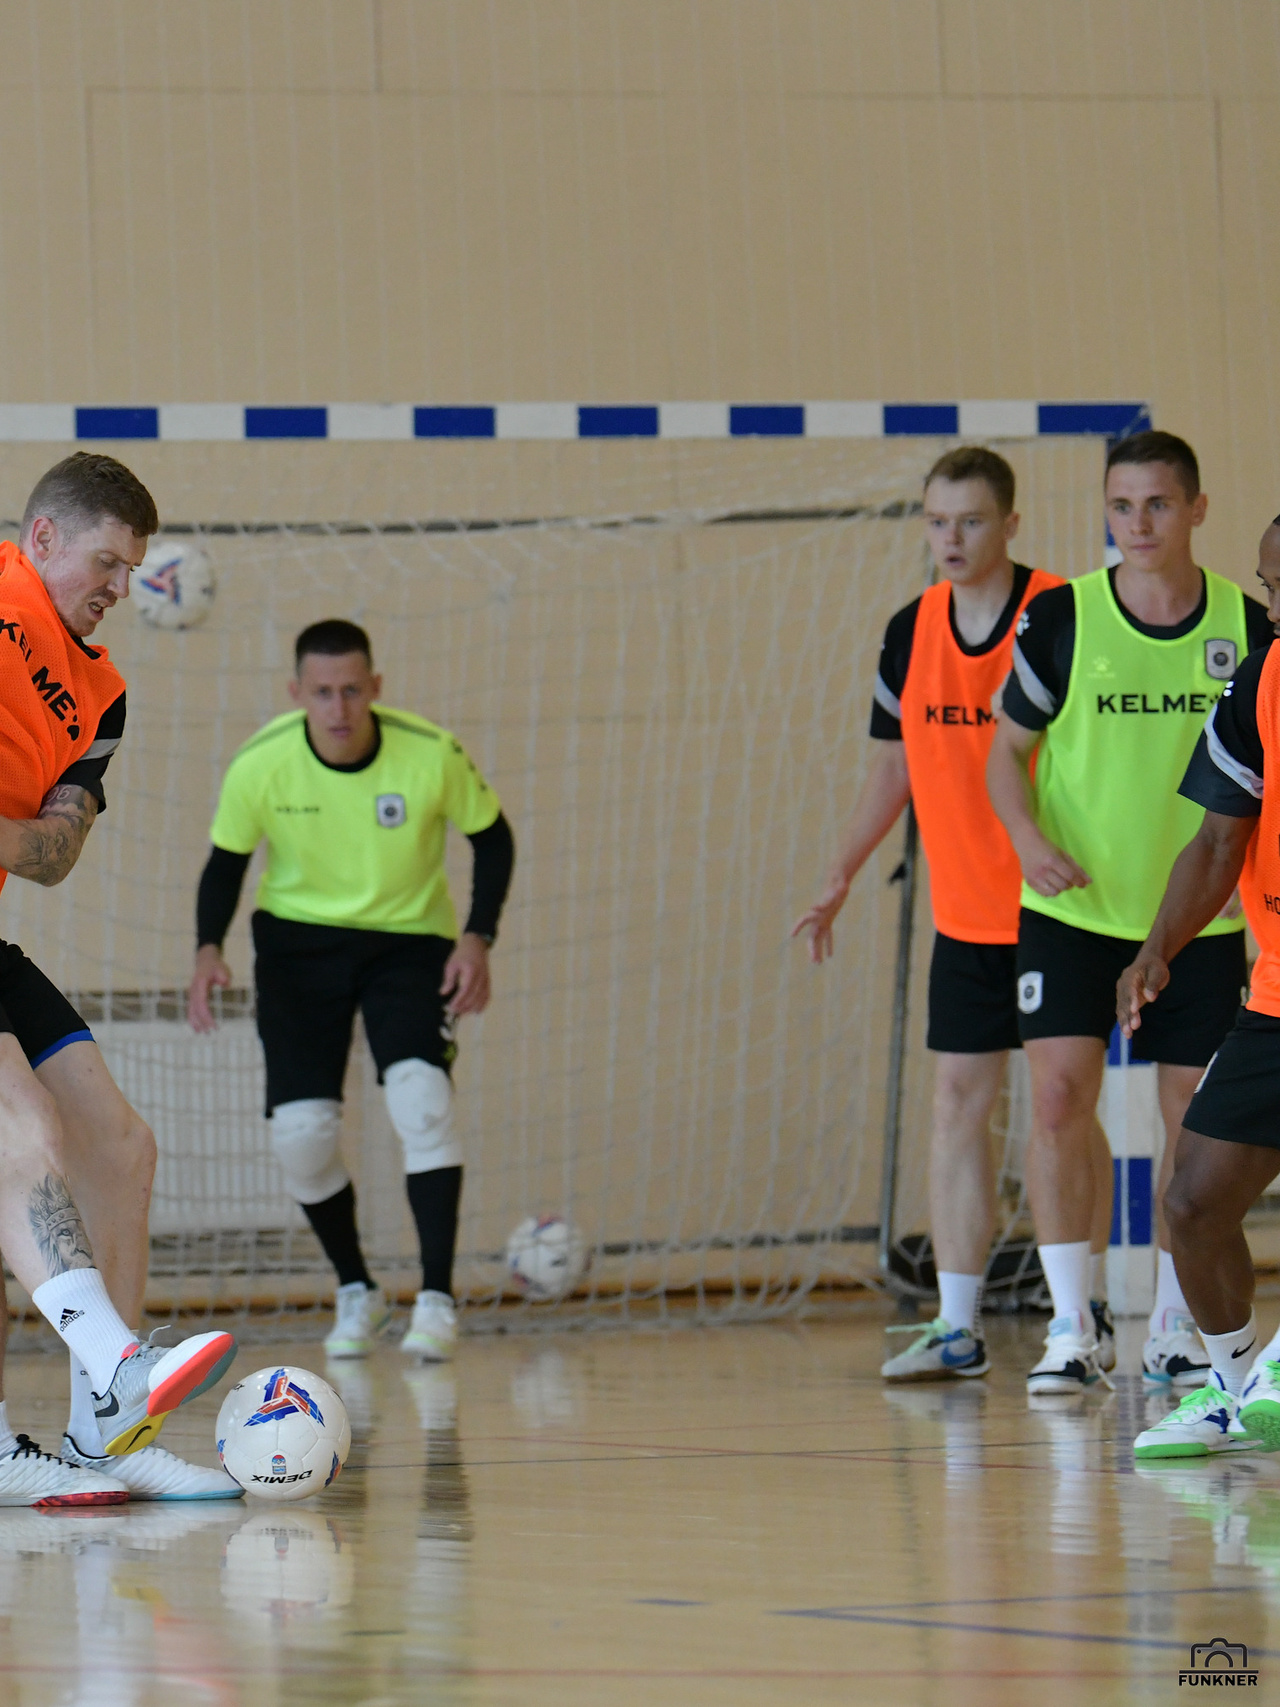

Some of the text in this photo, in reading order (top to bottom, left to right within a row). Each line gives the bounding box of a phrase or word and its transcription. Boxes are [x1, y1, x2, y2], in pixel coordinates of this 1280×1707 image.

[1097, 694, 1207, 713] KELME
[60, 1309, 85, 1332] adidas
[251, 1469, 313, 1484] DEMIX
